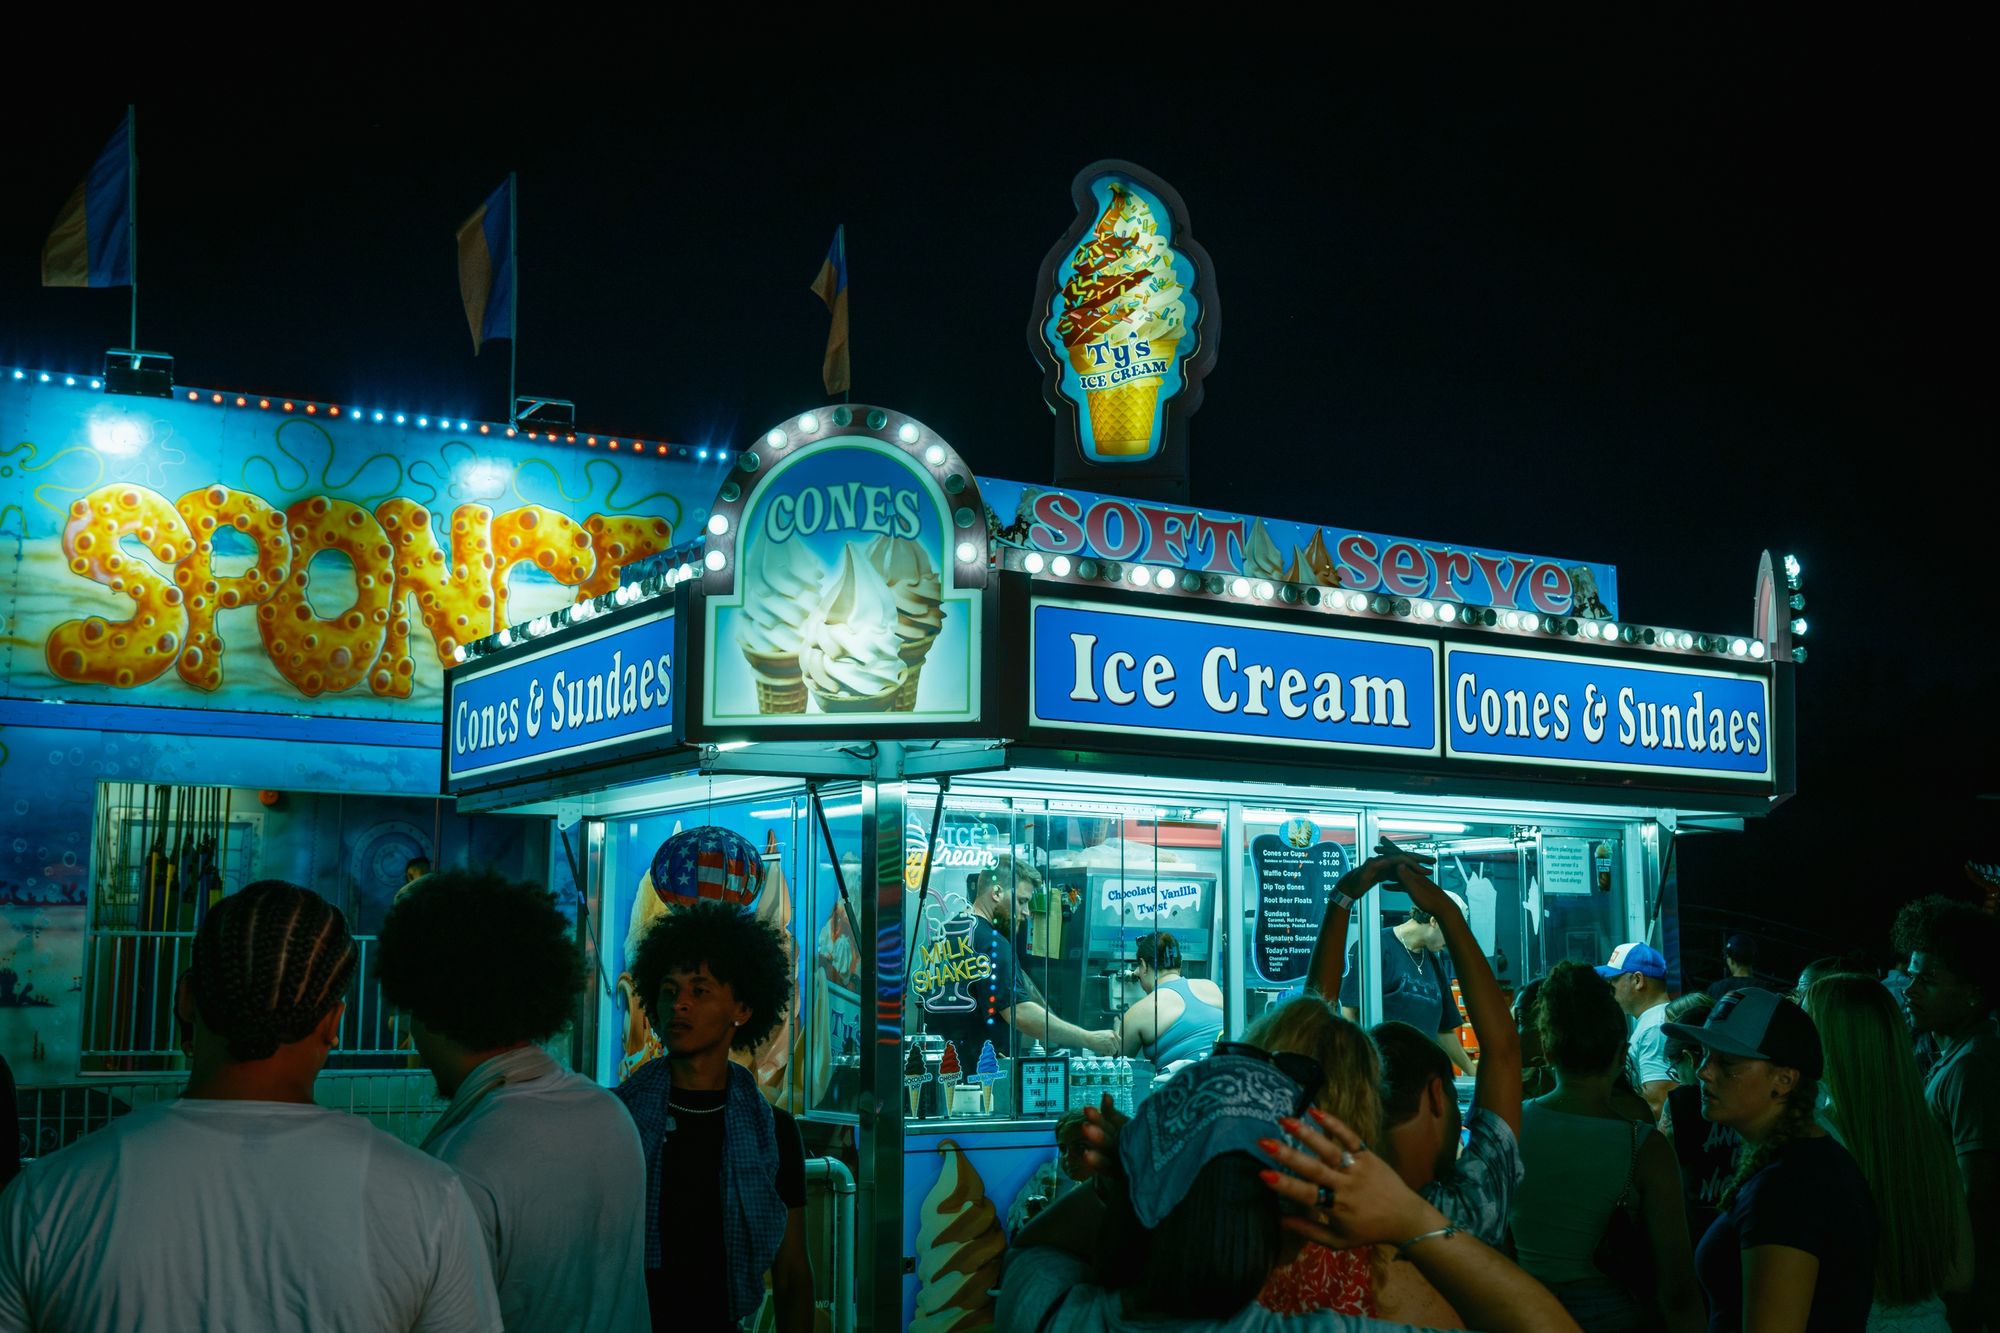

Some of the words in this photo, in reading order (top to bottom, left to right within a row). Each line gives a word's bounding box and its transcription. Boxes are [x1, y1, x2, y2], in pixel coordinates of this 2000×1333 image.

[1086, 332, 1151, 369] Ty's
[1080, 374, 1107, 389] ICE
[1110, 361, 1167, 384] CREAM
[766, 481, 920, 543] CONES
[1029, 491, 1247, 575] SOFT
[46, 482, 673, 698] SPON
[1069, 632, 1177, 709] Ice
[1201, 646, 1411, 729] Cream
[456, 695, 520, 755] Cones
[525, 678, 545, 738] &
[551, 650, 672, 731] Sundaes
[1455, 671, 1571, 741] Cones
[1582, 683, 1608, 743] &
[1619, 685, 1762, 757] Sundaes
[943, 827, 983, 847] ICE
[931, 838, 998, 867] Cream
[1290, 850, 1305, 858] Cups
[1108, 886, 1156, 901] Chocolate
[1160, 885, 1197, 900] Vanilla
[1263, 883, 1273, 891] Dip
[1275, 884, 1285, 892] Top
[1137, 901, 1168, 914] Twst
[921, 935, 974, 966] MILK
[1265, 947, 1288, 955] Today's
[914, 955, 991, 993] SHAKES
[904, 1073, 932, 1085] HOCOLATE
